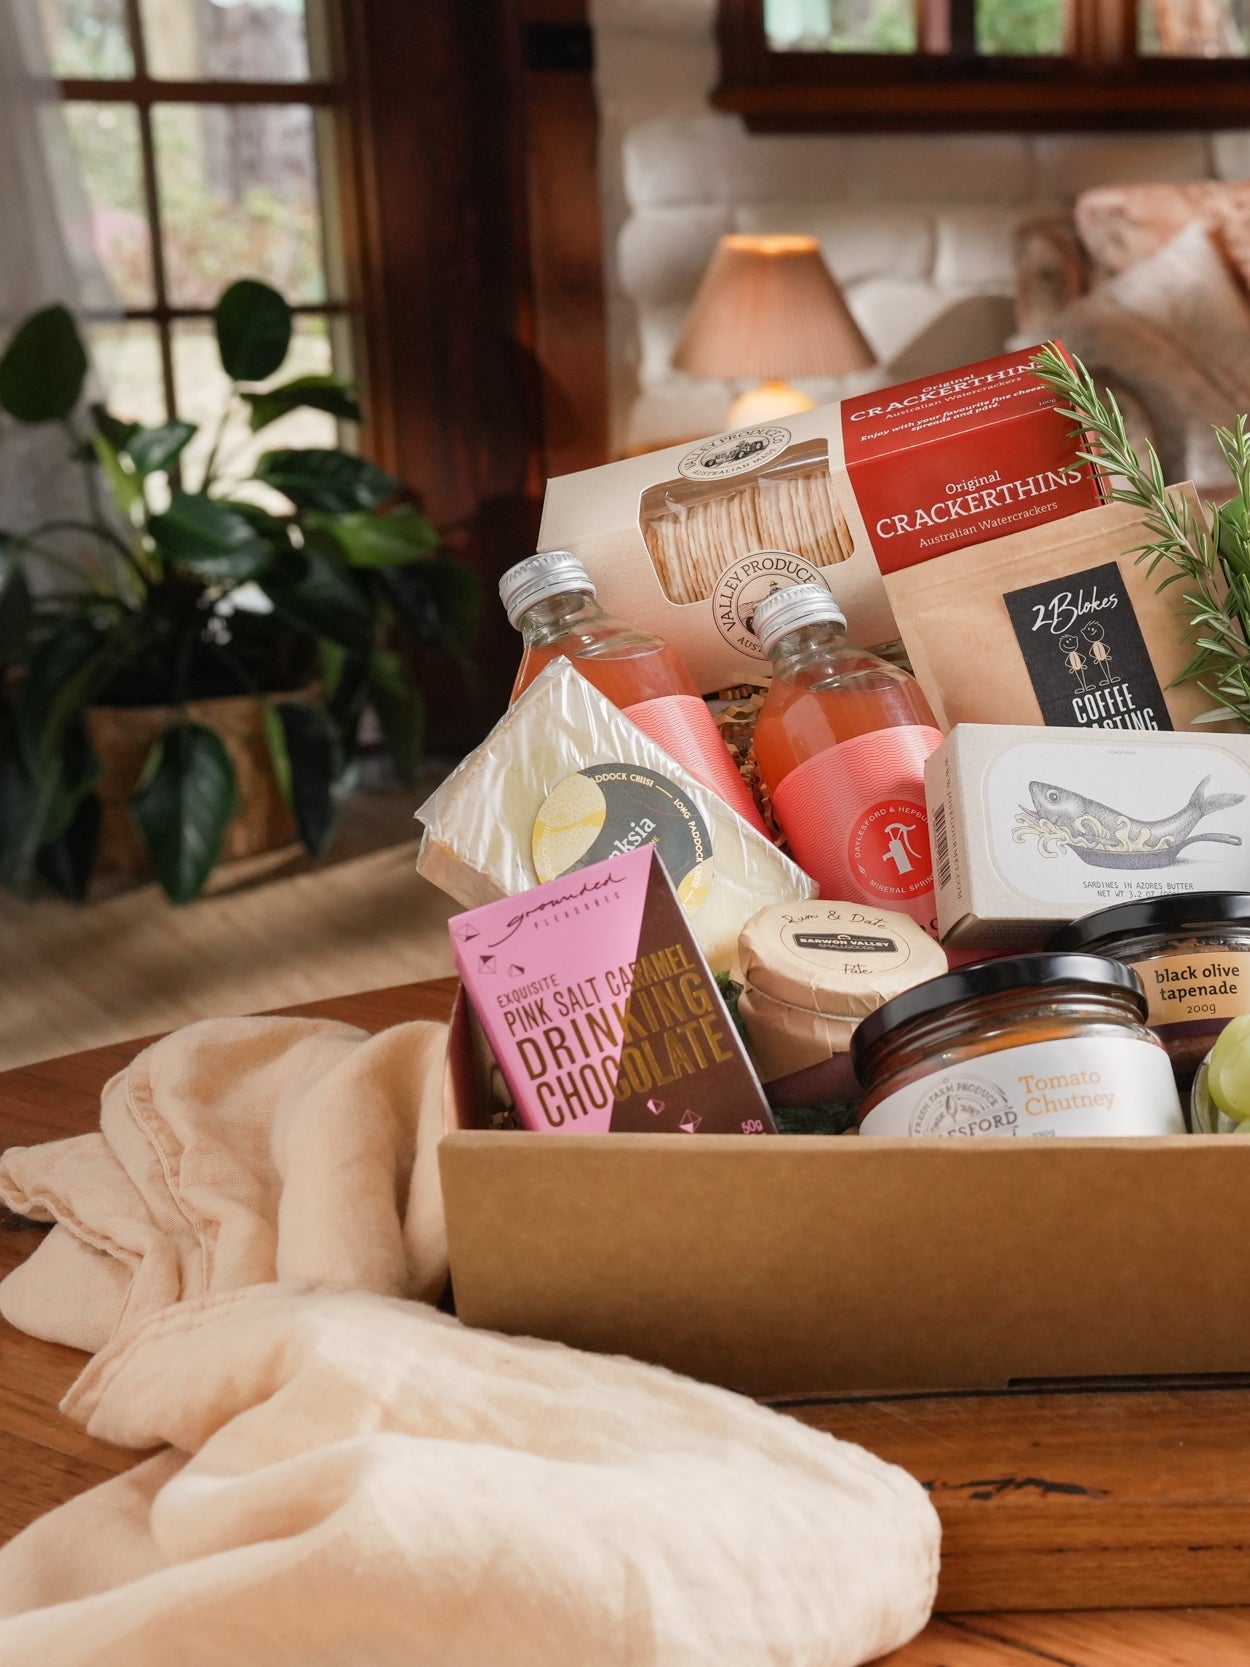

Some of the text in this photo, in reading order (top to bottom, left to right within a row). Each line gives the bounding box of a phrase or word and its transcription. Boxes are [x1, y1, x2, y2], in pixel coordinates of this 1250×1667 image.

[922, 374, 975, 393] Original
[885, 377, 1022, 419] Australian Watercrackers
[861, 430, 890, 441] Enjoy
[892, 422, 915, 432] with
[917, 414, 942, 426] your
[942, 400, 990, 419] favourite
[991, 394, 1012, 404] fine
[911, 416, 951, 431] spreads
[953, 410, 973, 419] and
[945, 470, 1001, 495] Original
[876, 466, 1082, 539] CRACKERTHINS
[919, 501, 1058, 548] Australian Watercrackers
[720, 557, 817, 632] VALLEY PRODUCE
[1072, 683, 1136, 724] COFFEE
[590, 772, 704, 863] DDOCK CHEESE LONG PADDOCK
[855, 809, 887, 858] DAYLESFORD
[898, 806, 928, 823] HEPBU
[869, 873, 934, 894] MINERAL SPRIN
[1082, 880, 1119, 889] SARDINES
[1136, 882, 1163, 890] AZORES
[1166, 882, 1194, 890] BUTTER
[1129, 890, 1142, 899] 3.2
[488, 873, 627, 948] grounded
[533, 891, 621, 930] PLEASURES
[827, 910, 840, 920] &
[849, 913, 889, 929] Date
[800, 938, 848, 946] BARWON
[1154, 964, 1240, 984] black olive
[497, 974, 560, 1008] EXQUISITE
[504, 944, 696, 1037] PINK SALT CARAMEL
[1160, 981, 1238, 1003] tapenade
[1187, 1003, 1216, 1015] 200g
[516, 972, 713, 1082] DRINKING
[536, 1015, 734, 1128] CHOCOLATE
[1018, 1069, 1100, 1095] Tomato
[929, 1083, 954, 1103] FARM
[956, 1082, 1001, 1107] PRODUCE
[1025, 1093, 1115, 1117] Chutney
[741, 1119, 764, 1134] 50g
